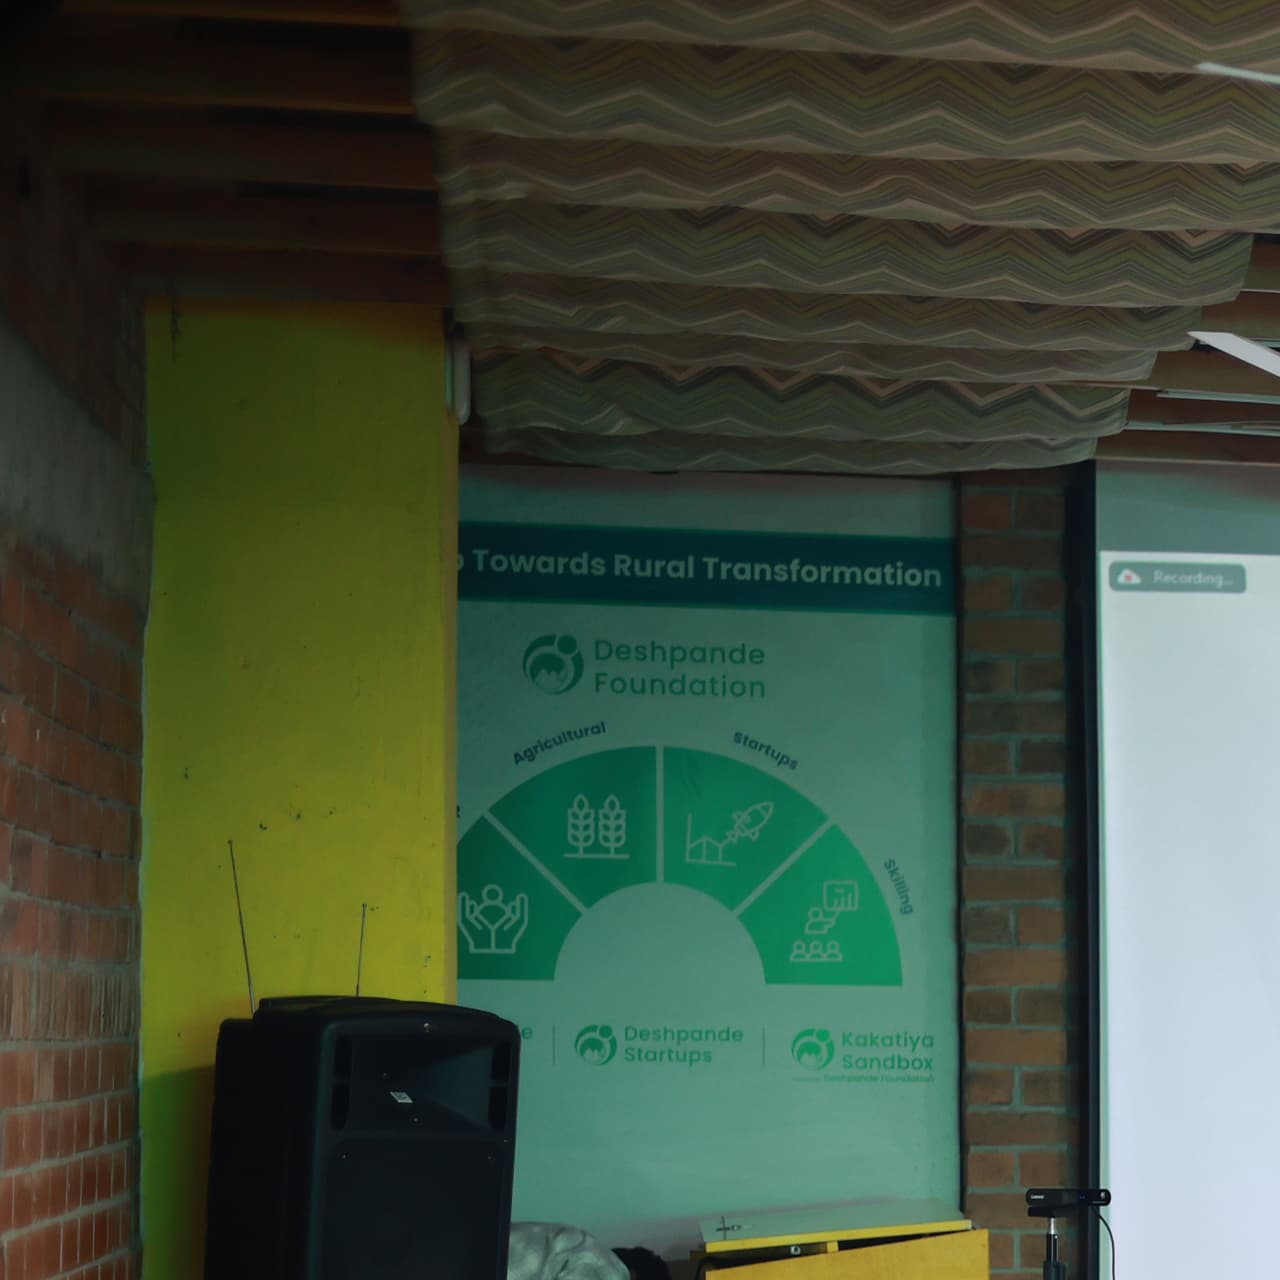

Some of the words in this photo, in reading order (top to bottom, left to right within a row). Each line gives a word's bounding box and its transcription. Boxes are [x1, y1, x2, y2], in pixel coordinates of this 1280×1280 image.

[471, 548, 607, 577] Towards
[614, 553, 695, 579] Rural
[702, 555, 942, 588] Transformation
[594, 639, 765, 669] Deshpande
[594, 672, 765, 698] Foundation
[513, 720, 607, 766] Agricultural
[733, 731, 799, 771] Startups
[884, 858, 914, 916] Skilling
[624, 1025, 744, 1046] Deshpande
[841, 1031, 935, 1053] Kakatiya
[624, 1046, 713, 1068] Startups
[841, 1053, 934, 1071] Sandbox
